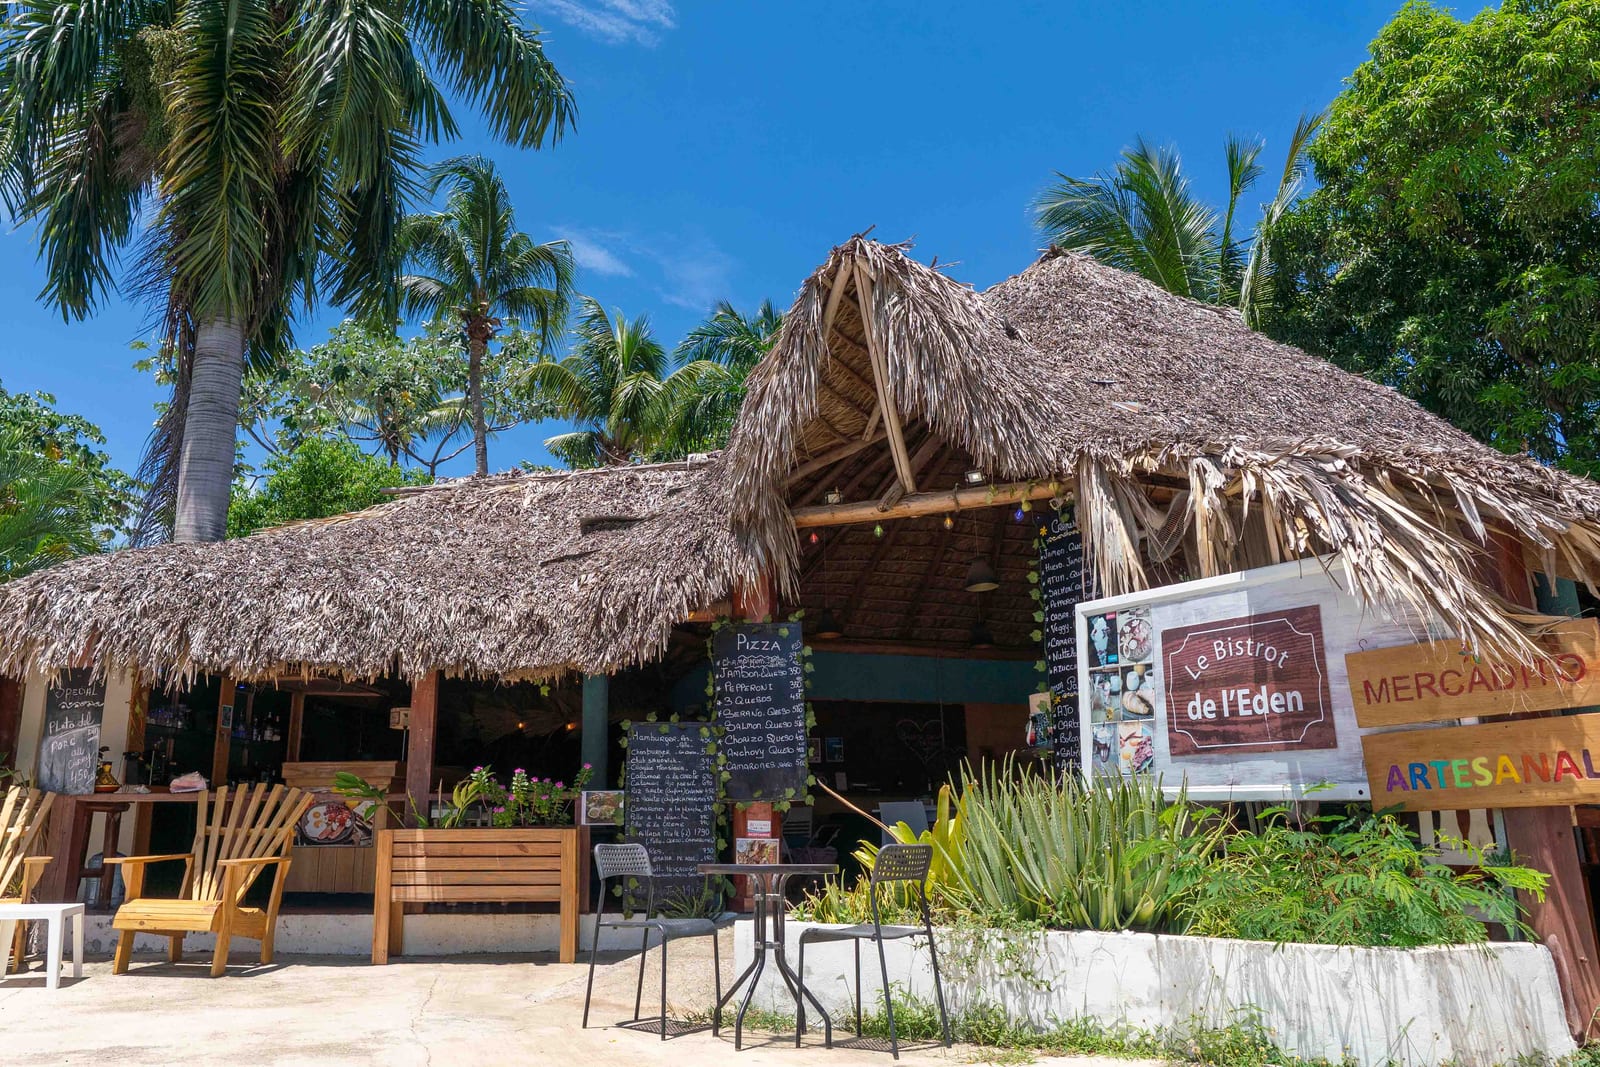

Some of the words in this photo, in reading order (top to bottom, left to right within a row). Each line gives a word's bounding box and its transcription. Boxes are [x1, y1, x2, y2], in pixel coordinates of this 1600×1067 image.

[1184, 655, 1210, 680] Le
[1213, 637, 1289, 669] Bistrot
[1187, 692, 1216, 721] de
[1221, 685, 1304, 718] l'Eden
[1386, 748, 1600, 793] ARTESANAL
